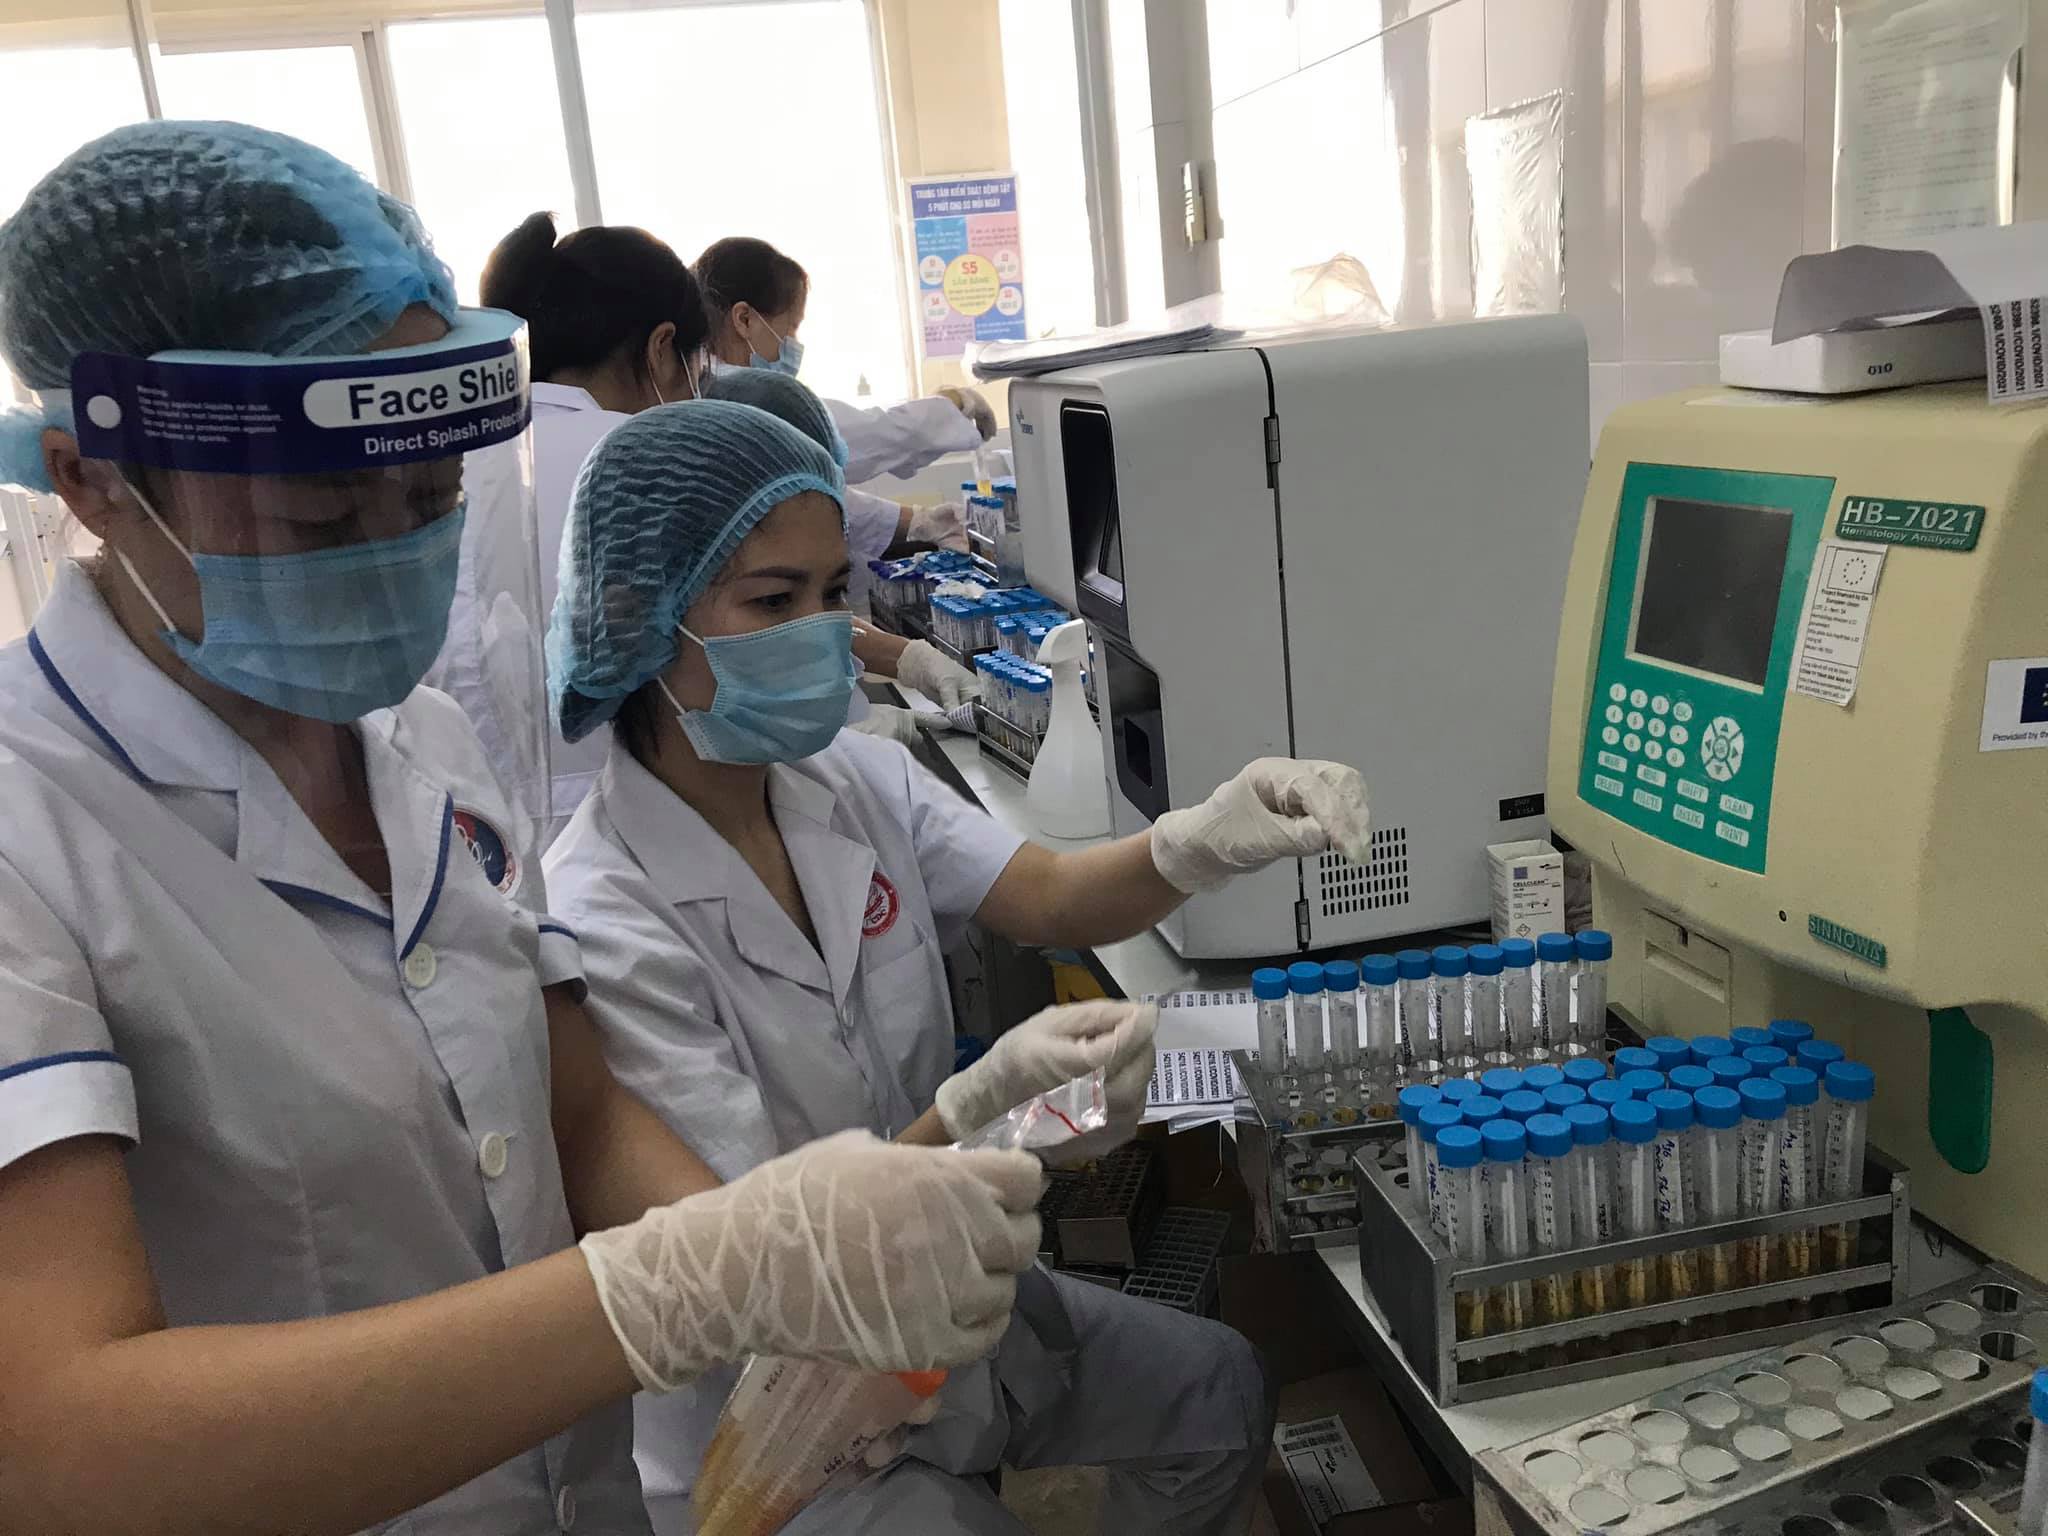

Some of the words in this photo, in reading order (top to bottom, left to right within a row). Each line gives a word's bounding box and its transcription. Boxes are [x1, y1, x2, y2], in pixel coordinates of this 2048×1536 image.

[961, 261, 978, 274] S5
[348, 384, 449, 420] Face
[459, 357, 520, 404] Shiel
[364, 434, 424, 455] Direct
[427, 421, 478, 448] Splash
[1842, 499, 1978, 533] HB-7021
[1841, 525, 1908, 542] Hematology
[1911, 532, 1966, 546] Analyzer
[1992, 731, 2027, 741] Provided
[2029, 731, 2038, 740] by
[1724, 798, 1748, 815] CLEAN
[1720, 825, 1744, 843] PRINT
